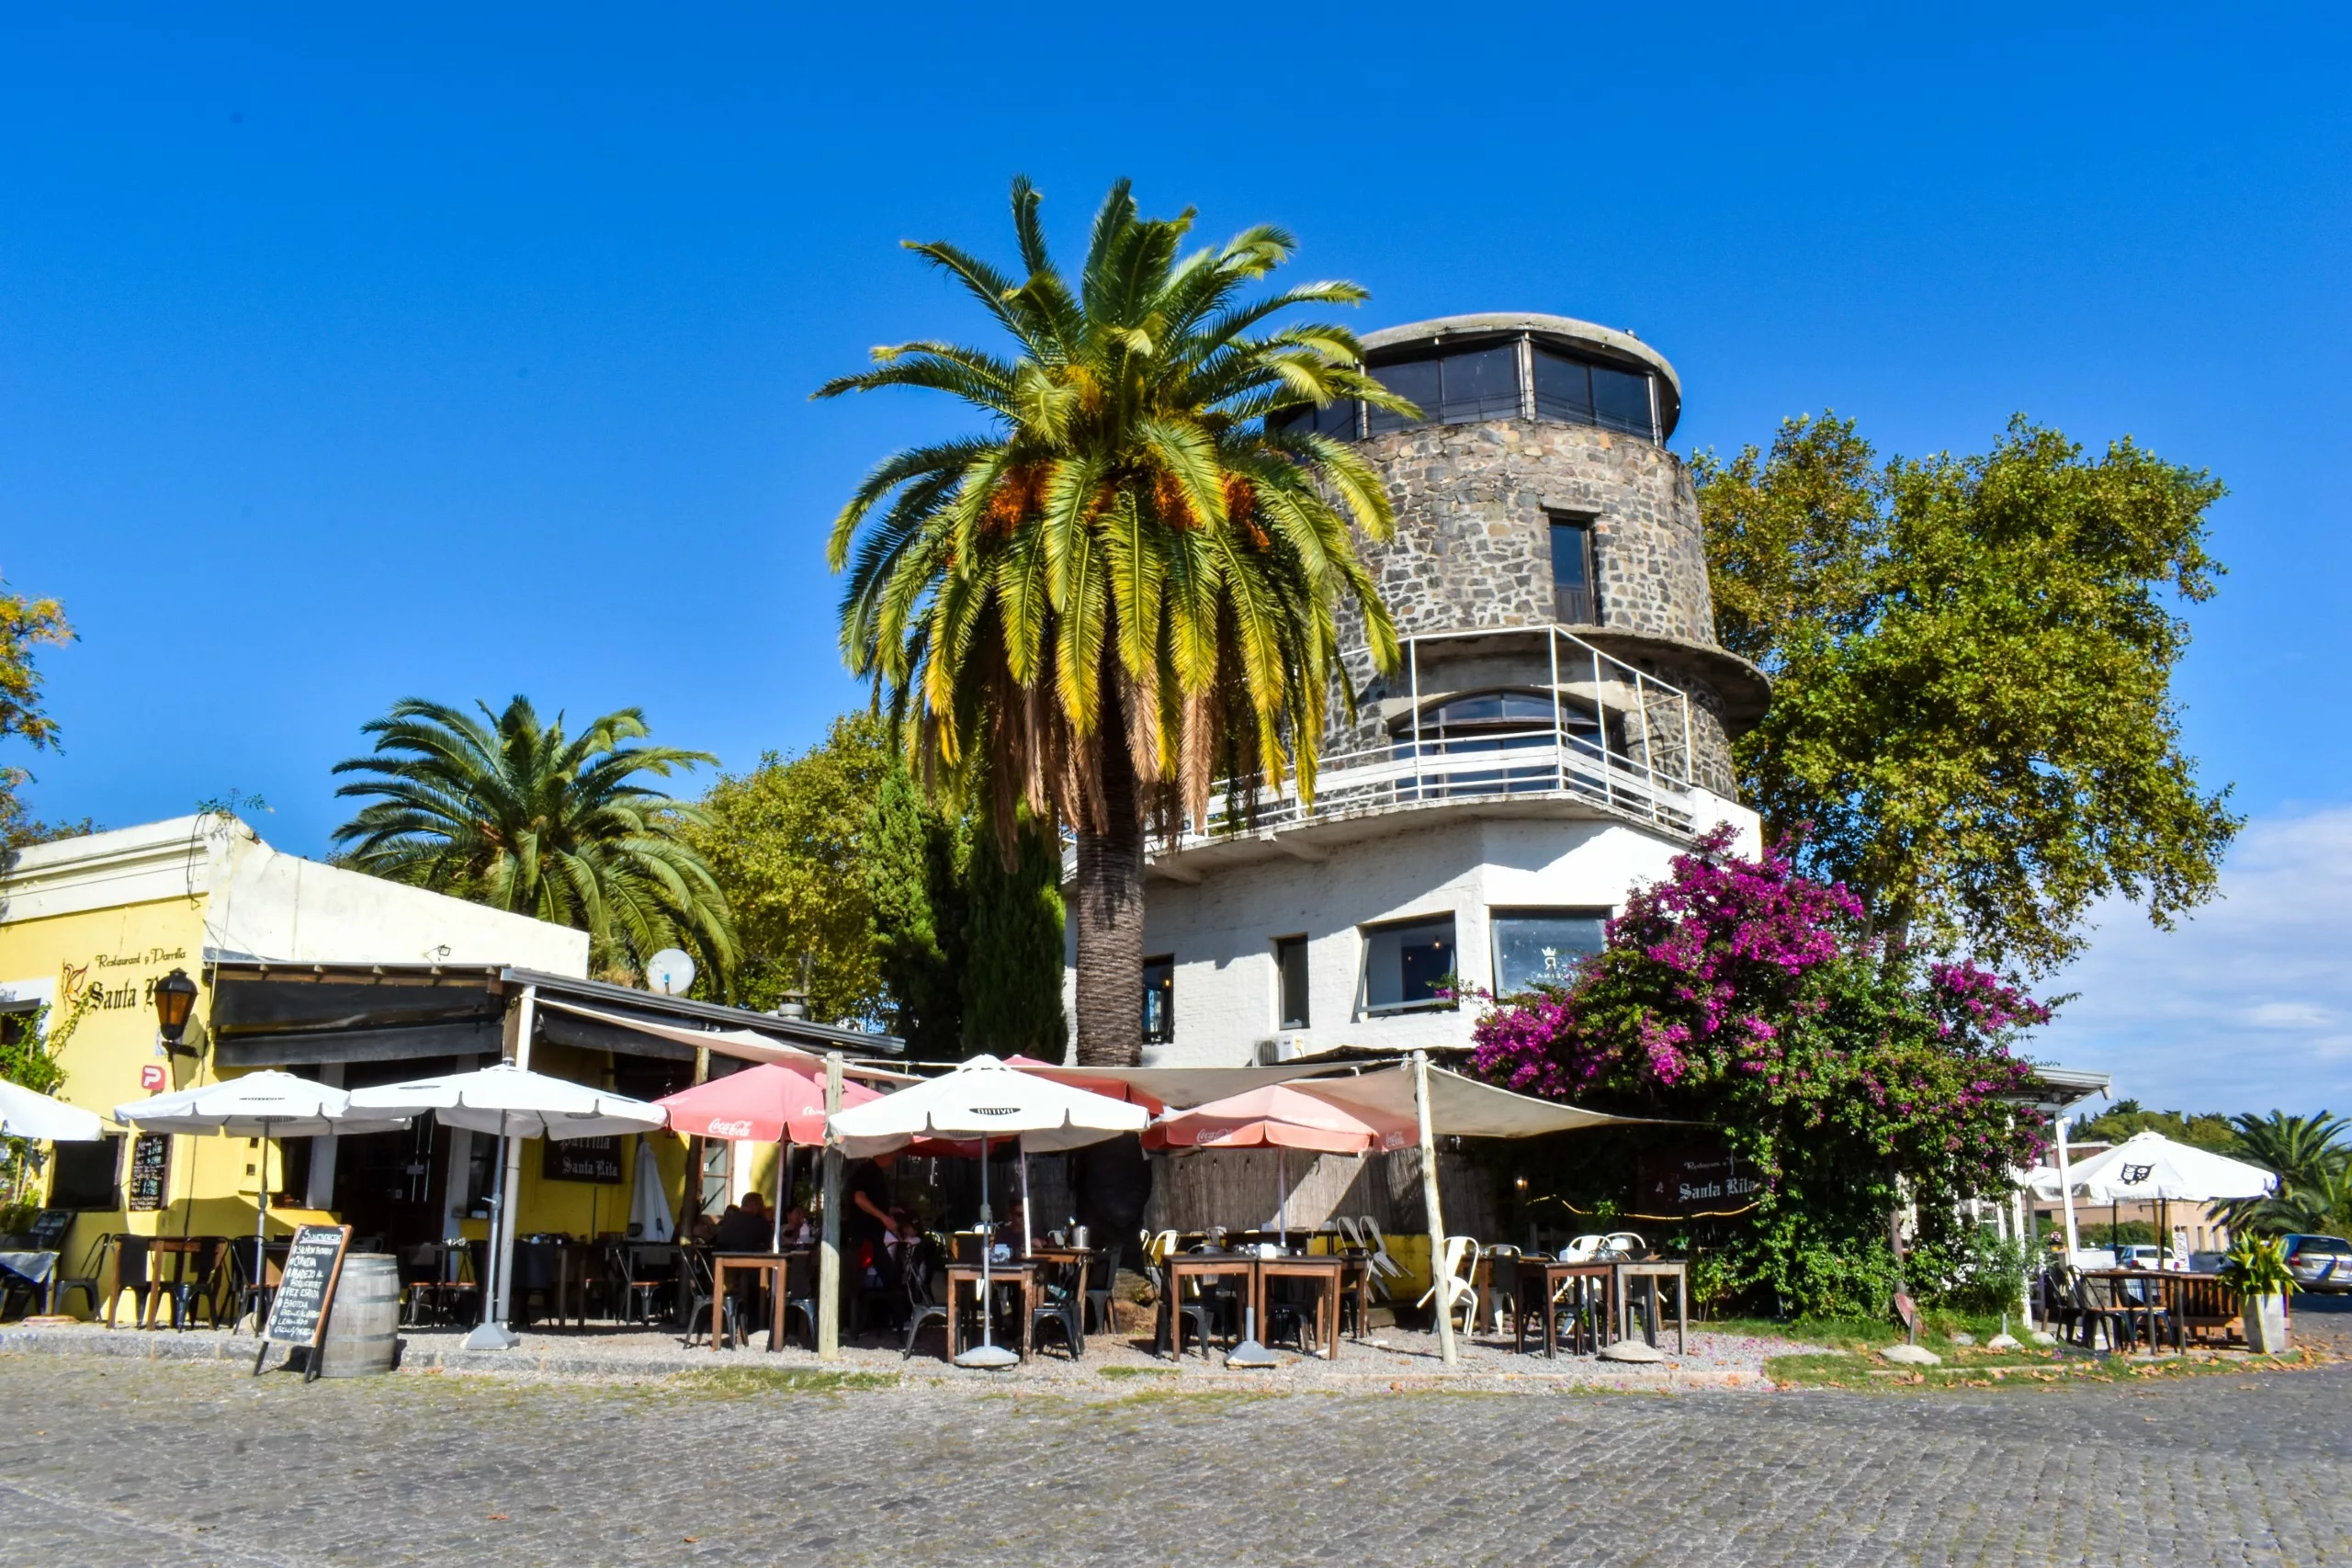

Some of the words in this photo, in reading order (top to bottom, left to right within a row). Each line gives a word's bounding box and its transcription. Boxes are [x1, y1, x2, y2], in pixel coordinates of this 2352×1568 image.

[87, 977, 136, 1015] Santa
[561, 1156, 594, 1175] Santa
[595, 1160, 618, 1179] Rita
[1678, 1180, 1721, 1203] Santa
[1725, 1177, 1757, 1197] Rita
